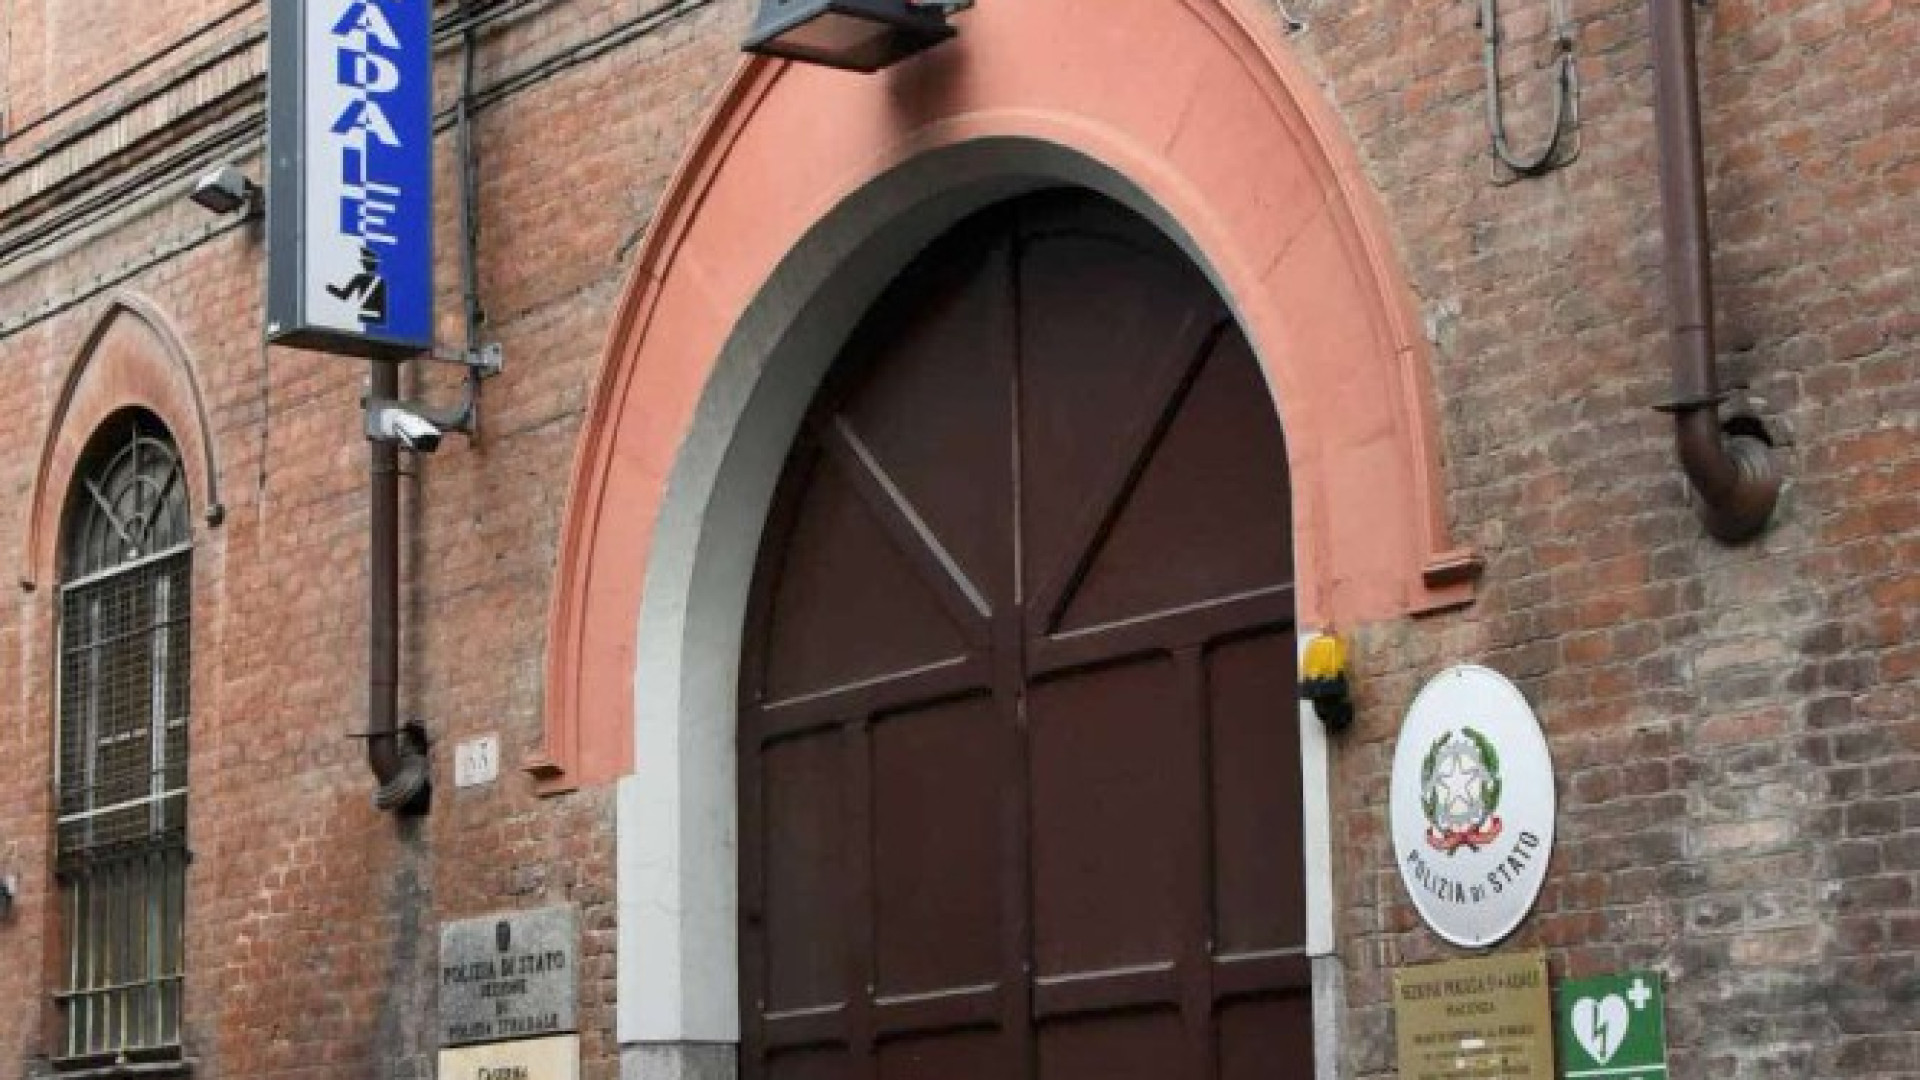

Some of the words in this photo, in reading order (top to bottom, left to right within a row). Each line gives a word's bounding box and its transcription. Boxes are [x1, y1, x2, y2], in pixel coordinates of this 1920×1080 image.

[1407, 849, 1465, 904] POLIZIA
[1487, 831, 1540, 893] STATO
[518, 950, 566, 974] STATO
